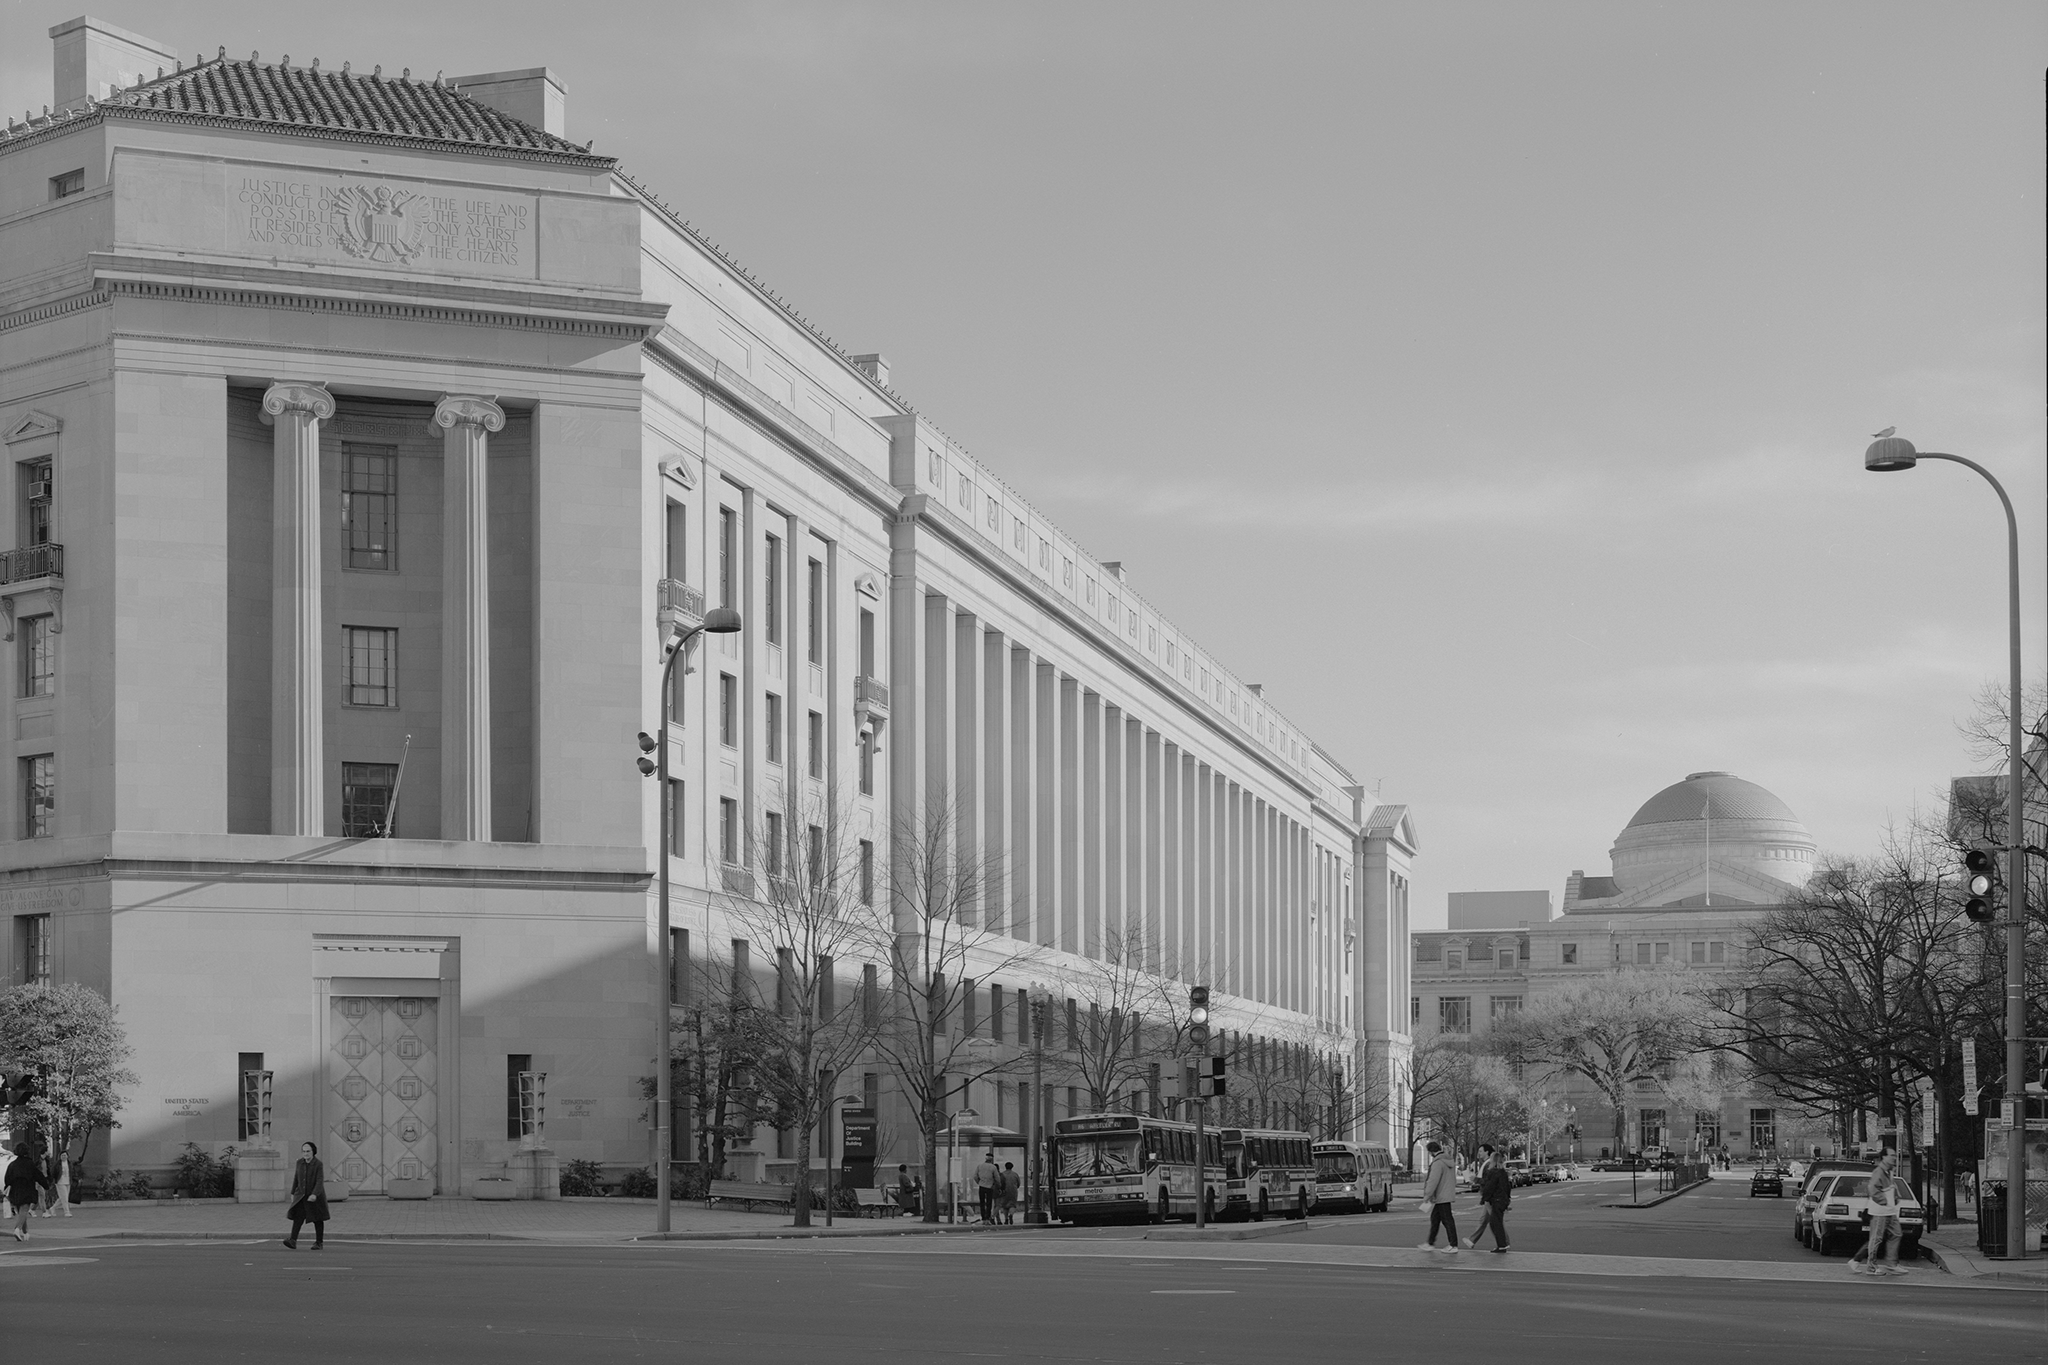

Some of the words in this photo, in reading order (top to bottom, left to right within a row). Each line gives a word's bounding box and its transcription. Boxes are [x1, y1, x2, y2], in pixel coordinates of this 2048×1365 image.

[240, 178, 311, 197] JUSTICE
[320, 185, 336, 199] IN
[238, 191, 312, 209] CONDUCT
[317, 198, 336, 212] OF
[430, 197, 457, 211] THE
[465, 200, 492, 215] LIFE
[497, 203, 528, 218] AND
[250, 204, 338, 224] POSSIBLE
[433, 209, 459, 224] THE
[466, 213, 505, 228] STATE
[513, 217, 527, 230] IS
[249, 217, 261, 229] IT
[266, 218, 322, 236] RESIDES
[326, 224, 341, 238] IN
[426, 221, 462, 236] ONLY
[464, 225, 482, 238] AS
[485, 227, 519, 242] FIRST
[247, 229, 275, 243] AND
[279, 232, 323, 248] SOULS
[327, 237, 341, 250] OF
[433, 234, 459, 248] THE
[466, 237, 519, 253] HEARTS
[428, 246, 453, 260] THE
[456, 249, 520, 266] CITIZENS.
[18, 890, 45, 901] ALONE
[46, 889, 64, 899] CAN
[28, 898, 64, 910] FREEDOM
